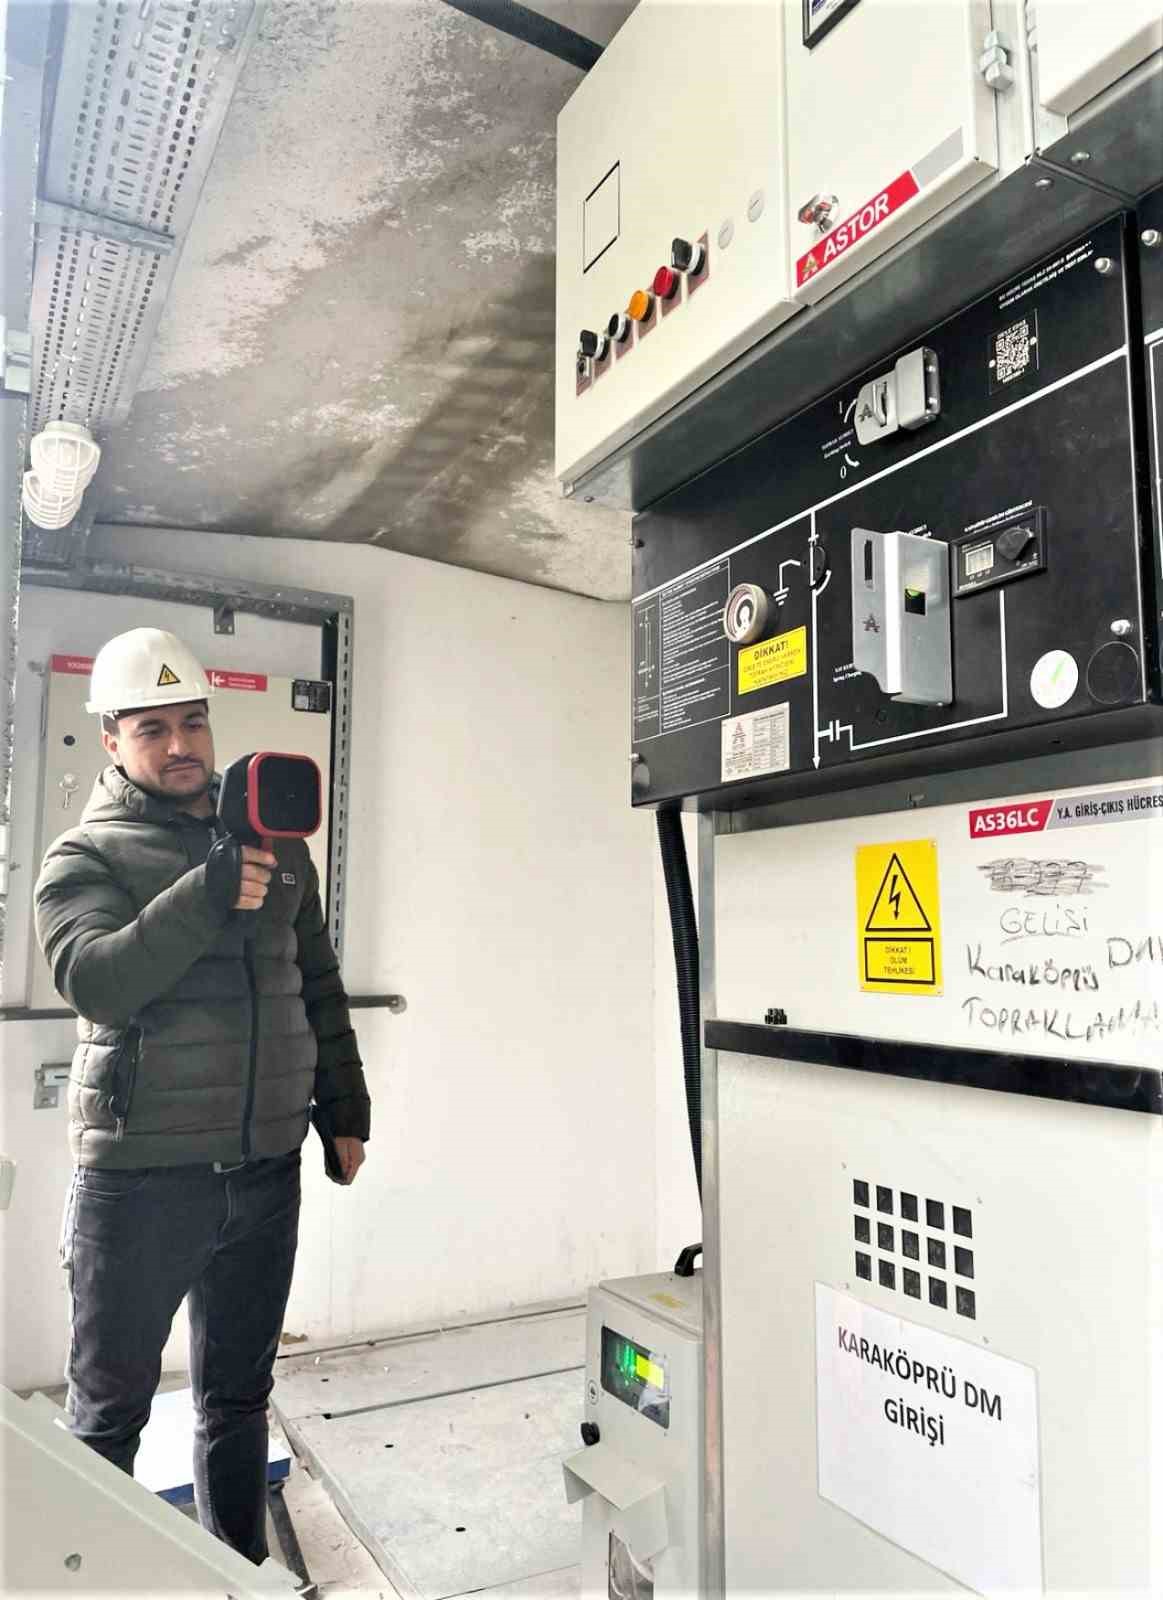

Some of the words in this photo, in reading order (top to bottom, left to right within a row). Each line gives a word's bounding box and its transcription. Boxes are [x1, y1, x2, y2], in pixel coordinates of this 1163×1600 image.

[823, 193, 889, 263] ASTOR
[974, 808, 1039, 833] AS36LC
[838, 1326, 957, 1399] KARAKÖPRÜ
[964, 1381, 1002, 1421] DM
[884, 1398, 945, 1447] GİRİŞİ
